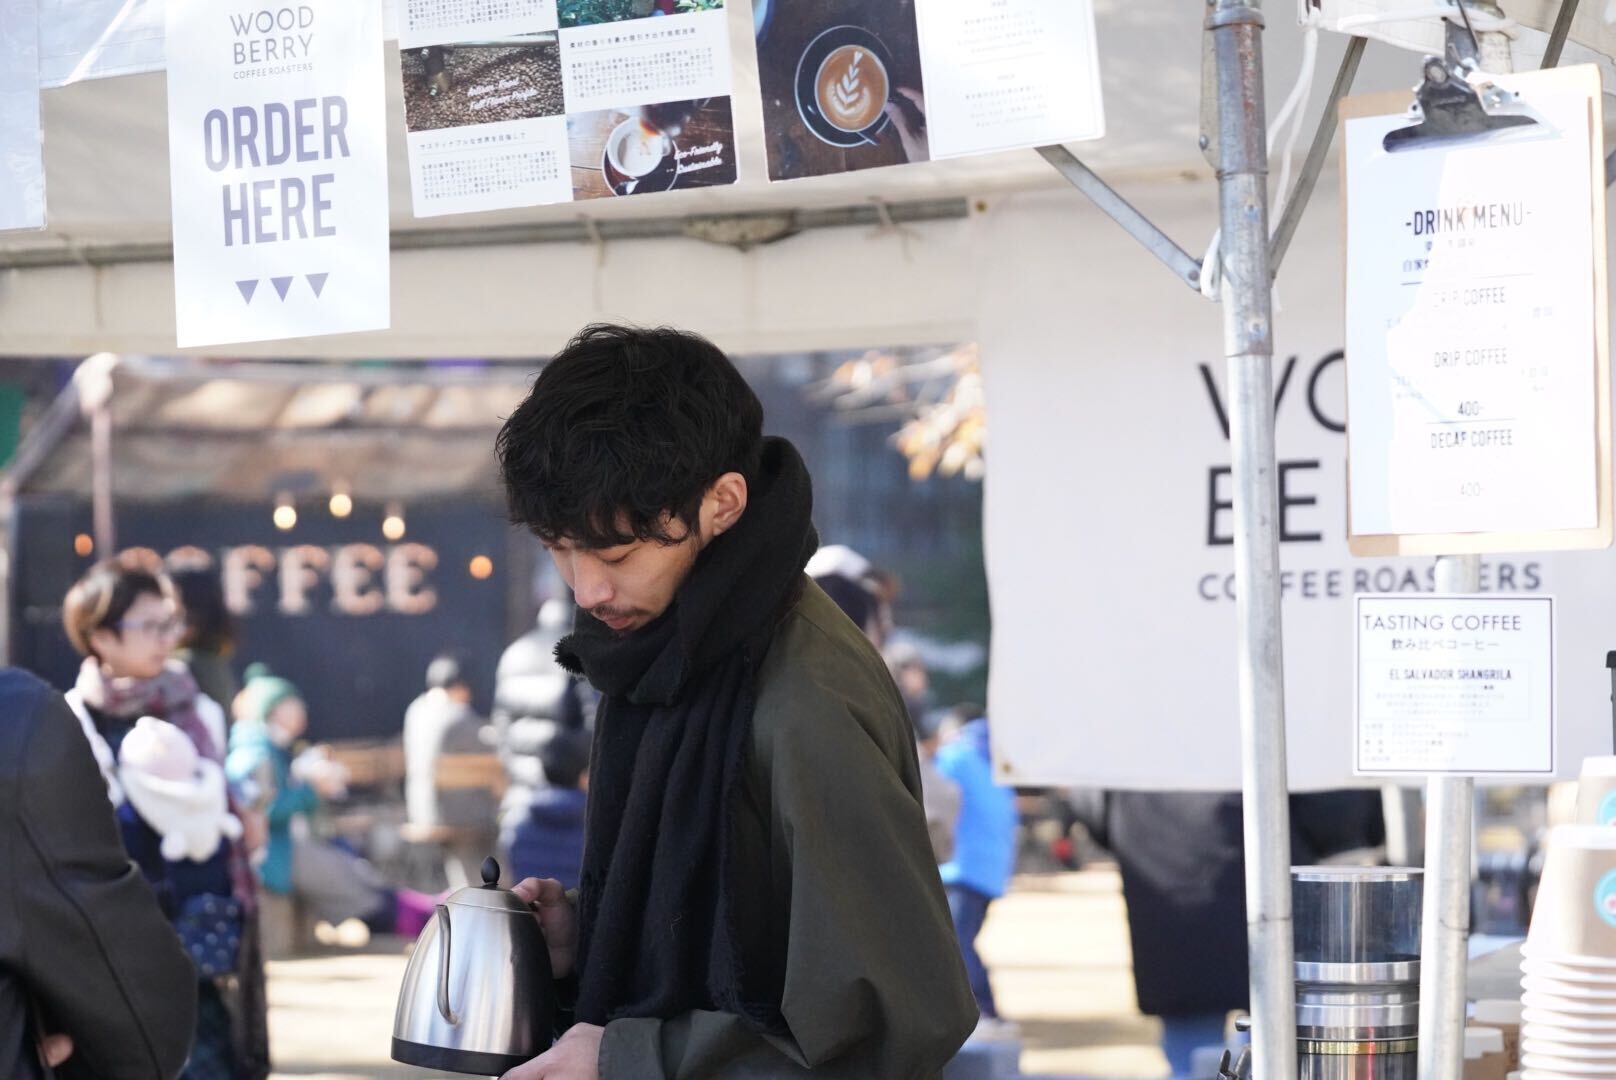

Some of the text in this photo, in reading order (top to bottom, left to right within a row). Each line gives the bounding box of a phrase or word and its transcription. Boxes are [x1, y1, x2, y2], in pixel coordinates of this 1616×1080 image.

[229, 6, 314, 36] WOOD
[234, 33, 313, 65] BERRY
[233, 62, 313, 79] COFFEE ROASTERS
[203, 96, 350, 172] ORDER
[222, 173, 336, 247] HERE
[1199, 562, 1542, 601] CFEE ROAERS
[1363, 615, 1521, 631] TASTING COFFEE
